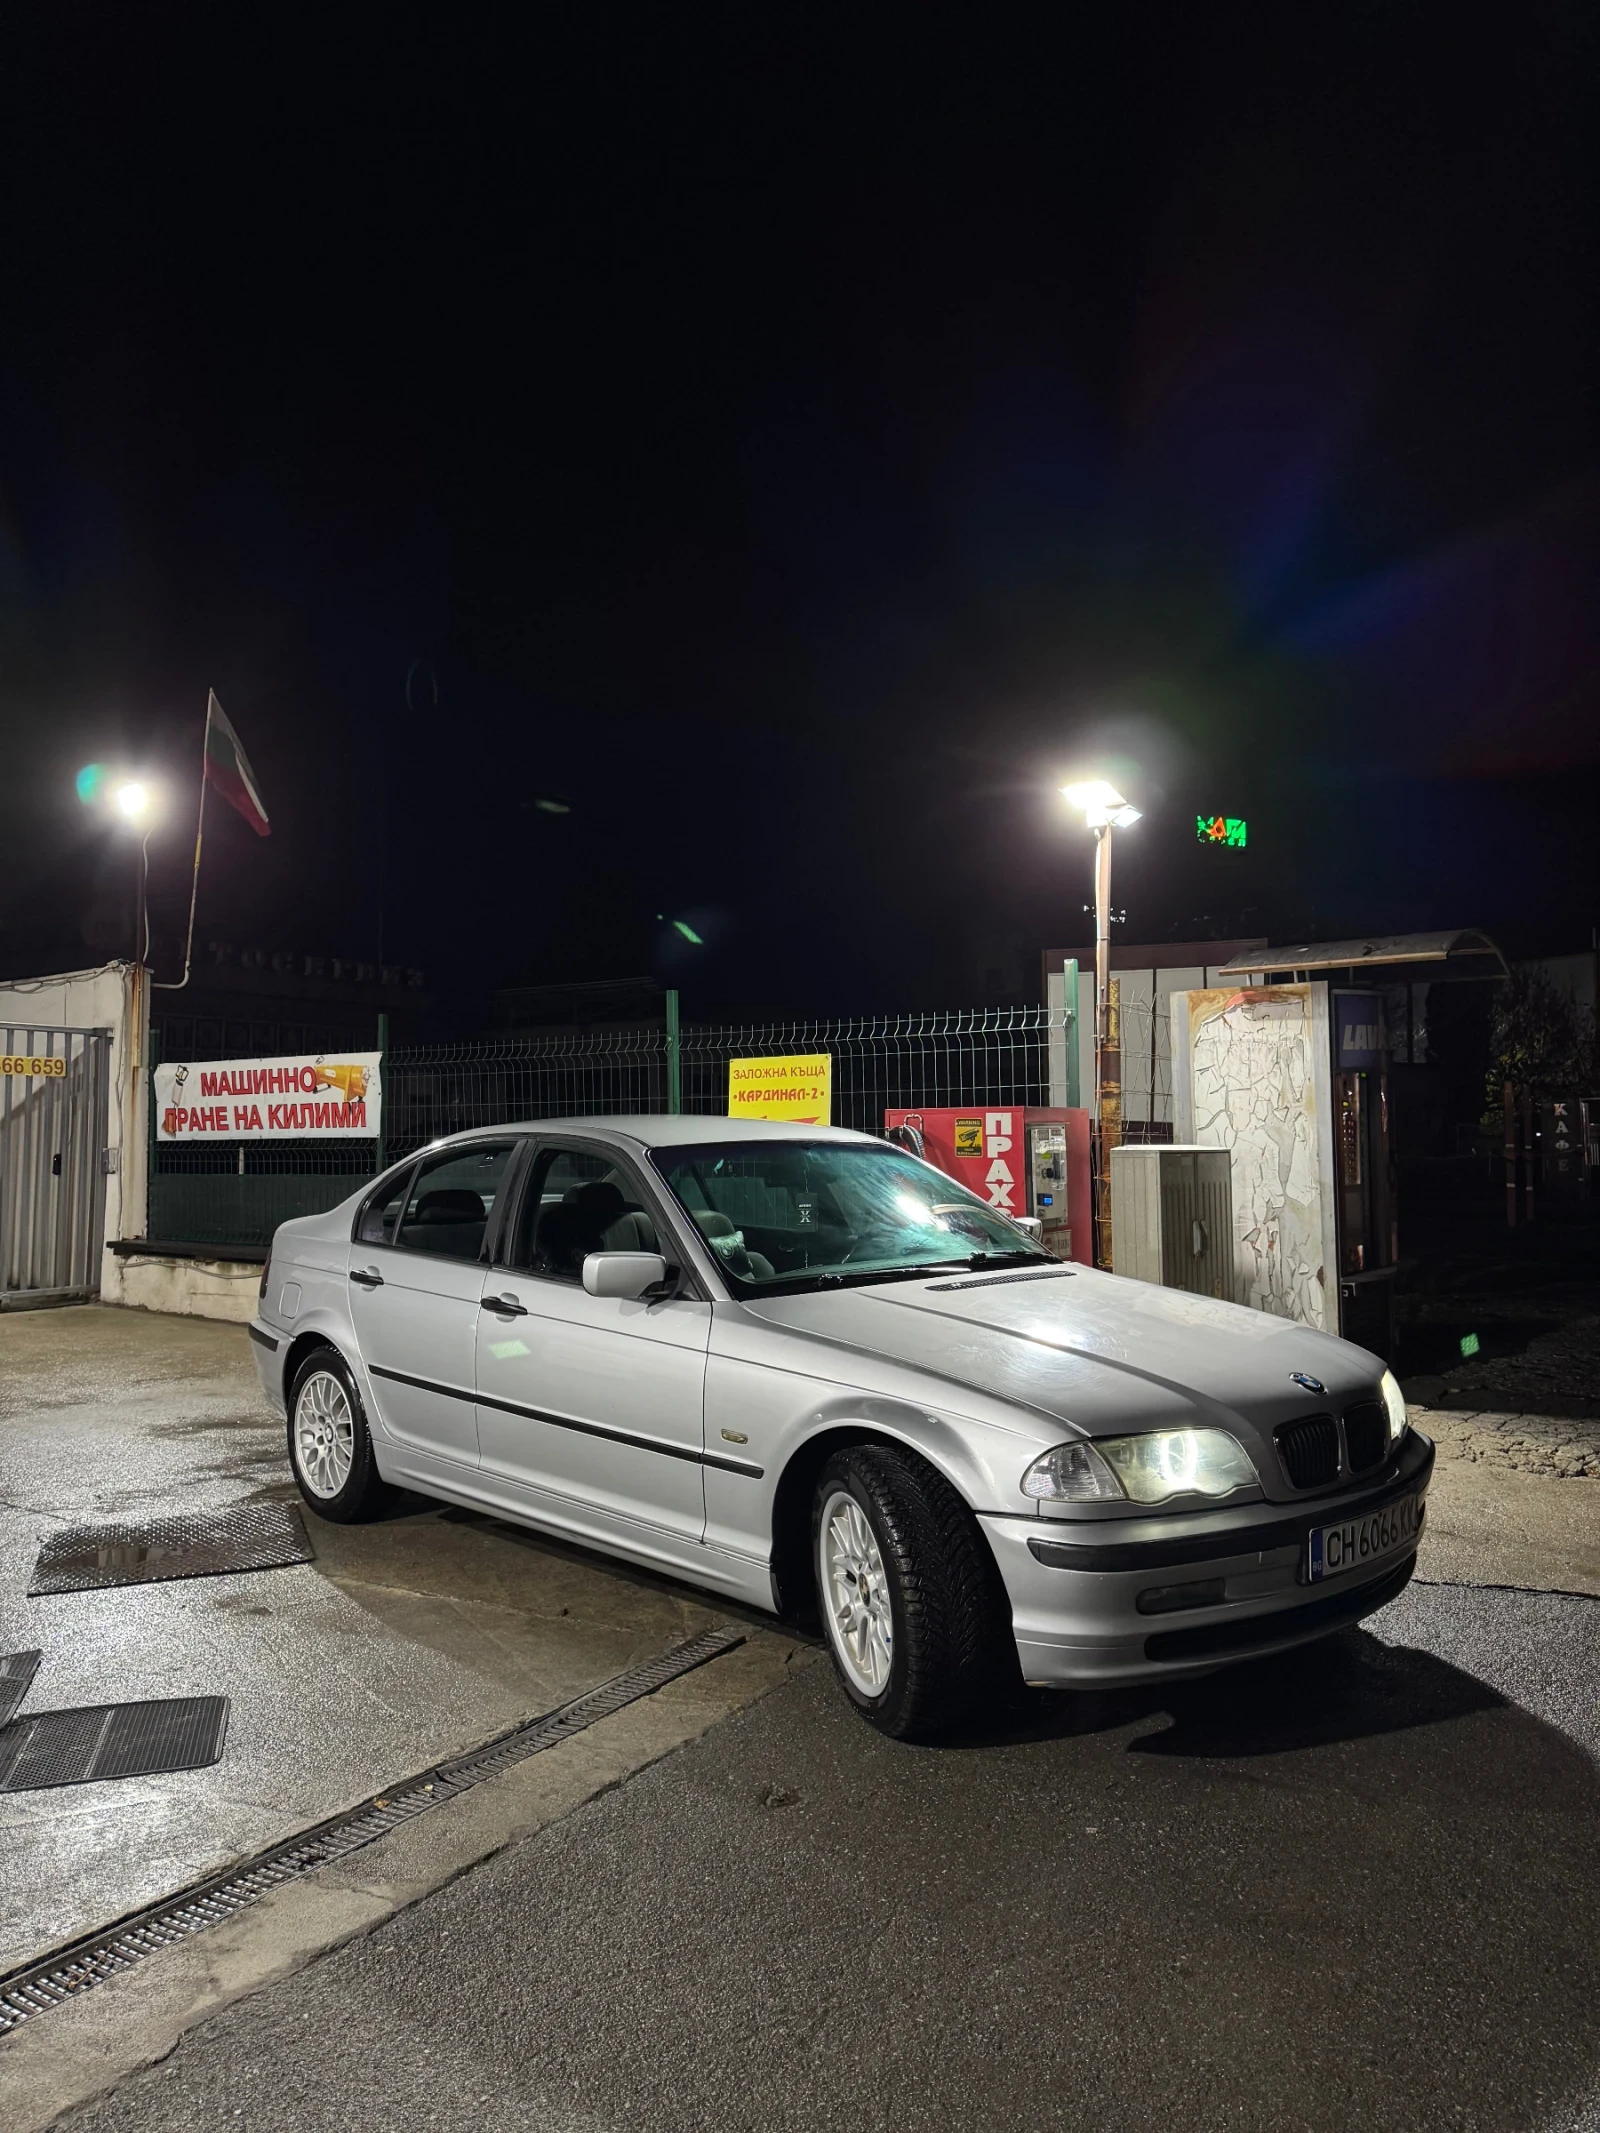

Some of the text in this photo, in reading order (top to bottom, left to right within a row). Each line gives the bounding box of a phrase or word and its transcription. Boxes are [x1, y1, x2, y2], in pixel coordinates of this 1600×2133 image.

[0, 1057, 64, 1075] 66 659
[733, 1065, 825, 1080] ЗАЛОЖНА КЪЩА
[200, 1066, 317, 1096] МАШИННО
[165, 1101, 367, 1132] ПРАНЕ НА КИЛИМИ
[1553, 1103, 1570, 1172] КАФЕ
[1312, 1560, 1322, 1572] BG
